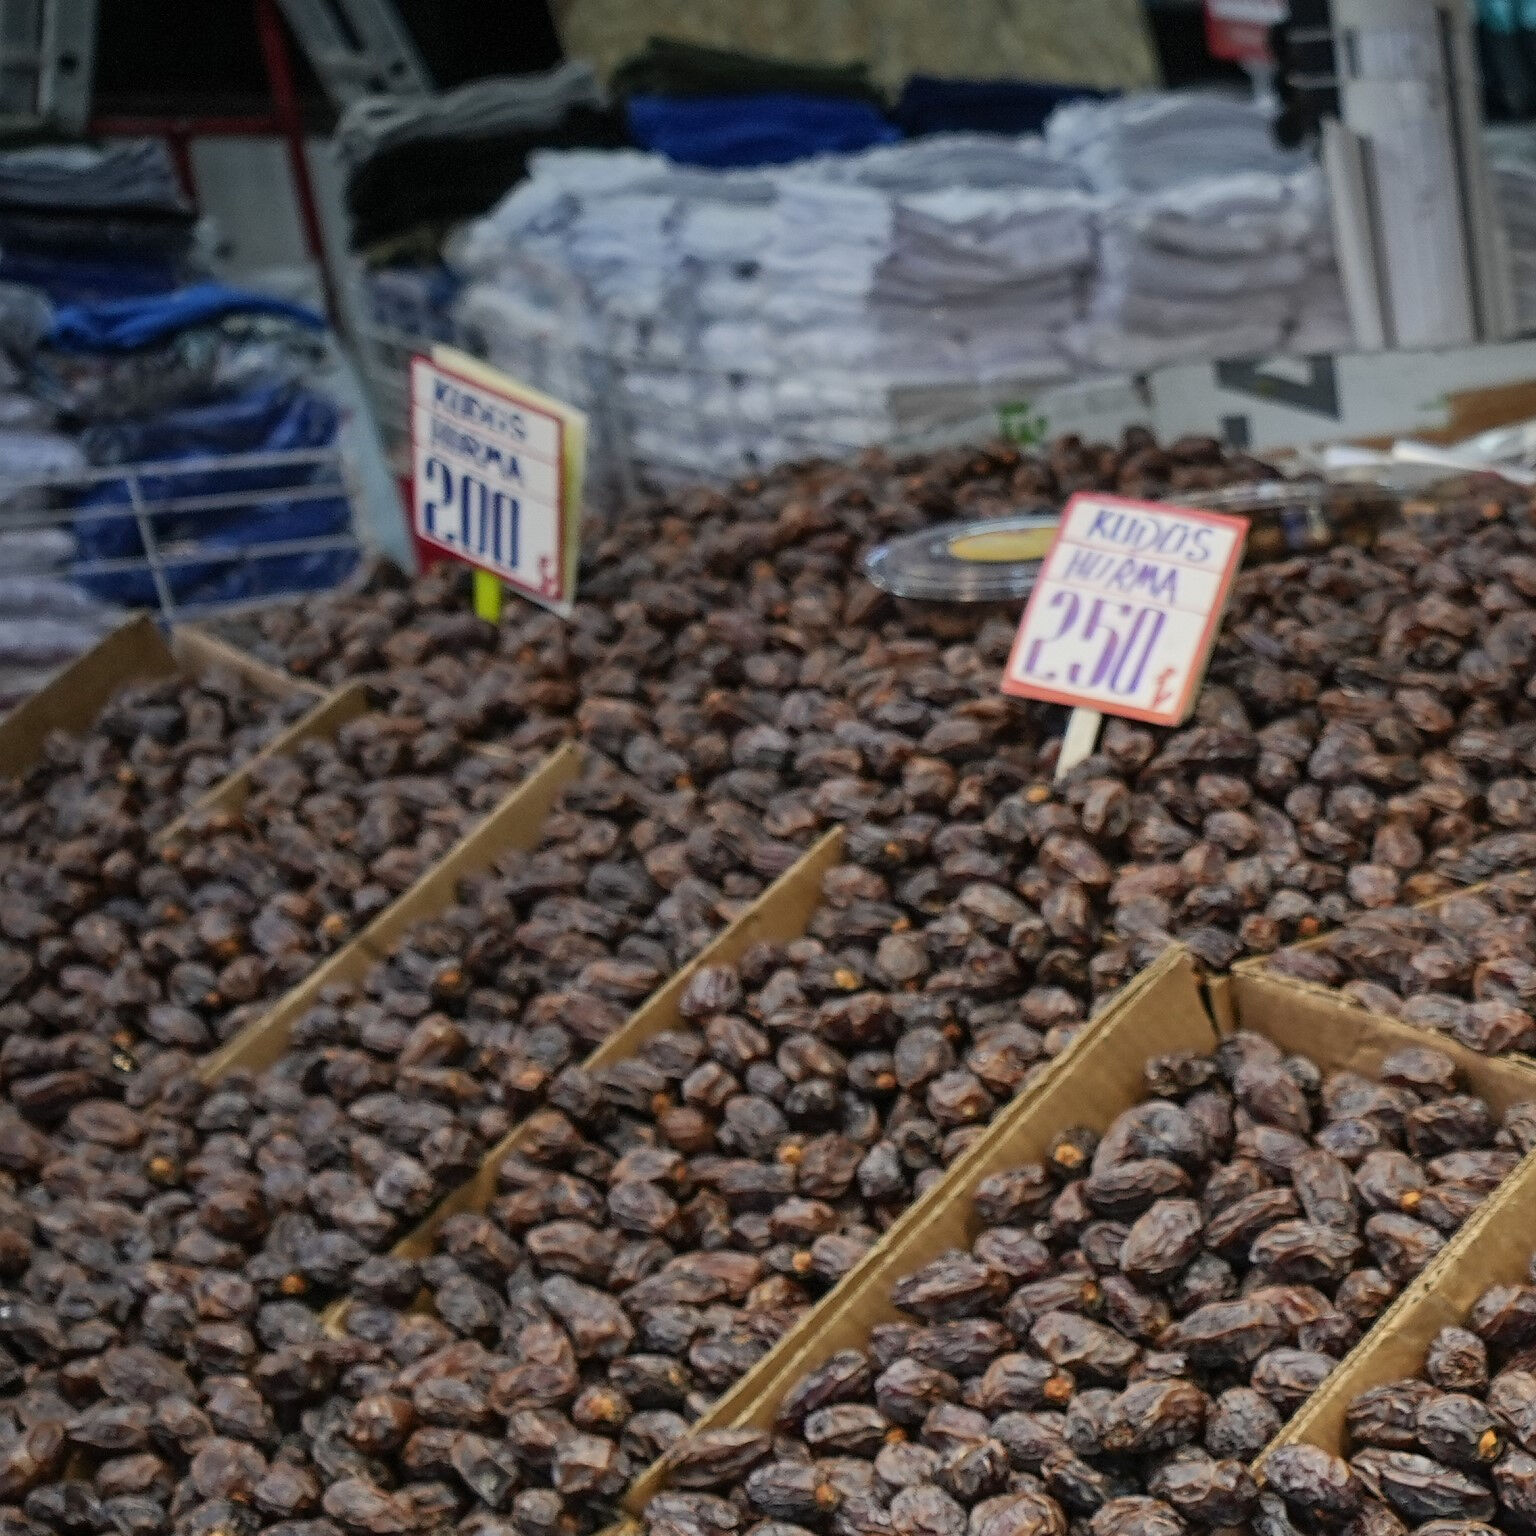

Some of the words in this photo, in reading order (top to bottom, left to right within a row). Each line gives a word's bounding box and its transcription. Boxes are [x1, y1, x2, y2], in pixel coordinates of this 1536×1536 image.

[425, 457, 520, 569] 200
[1062, 547, 1180, 607] HURMA
[1024, 590, 1168, 697] 250
